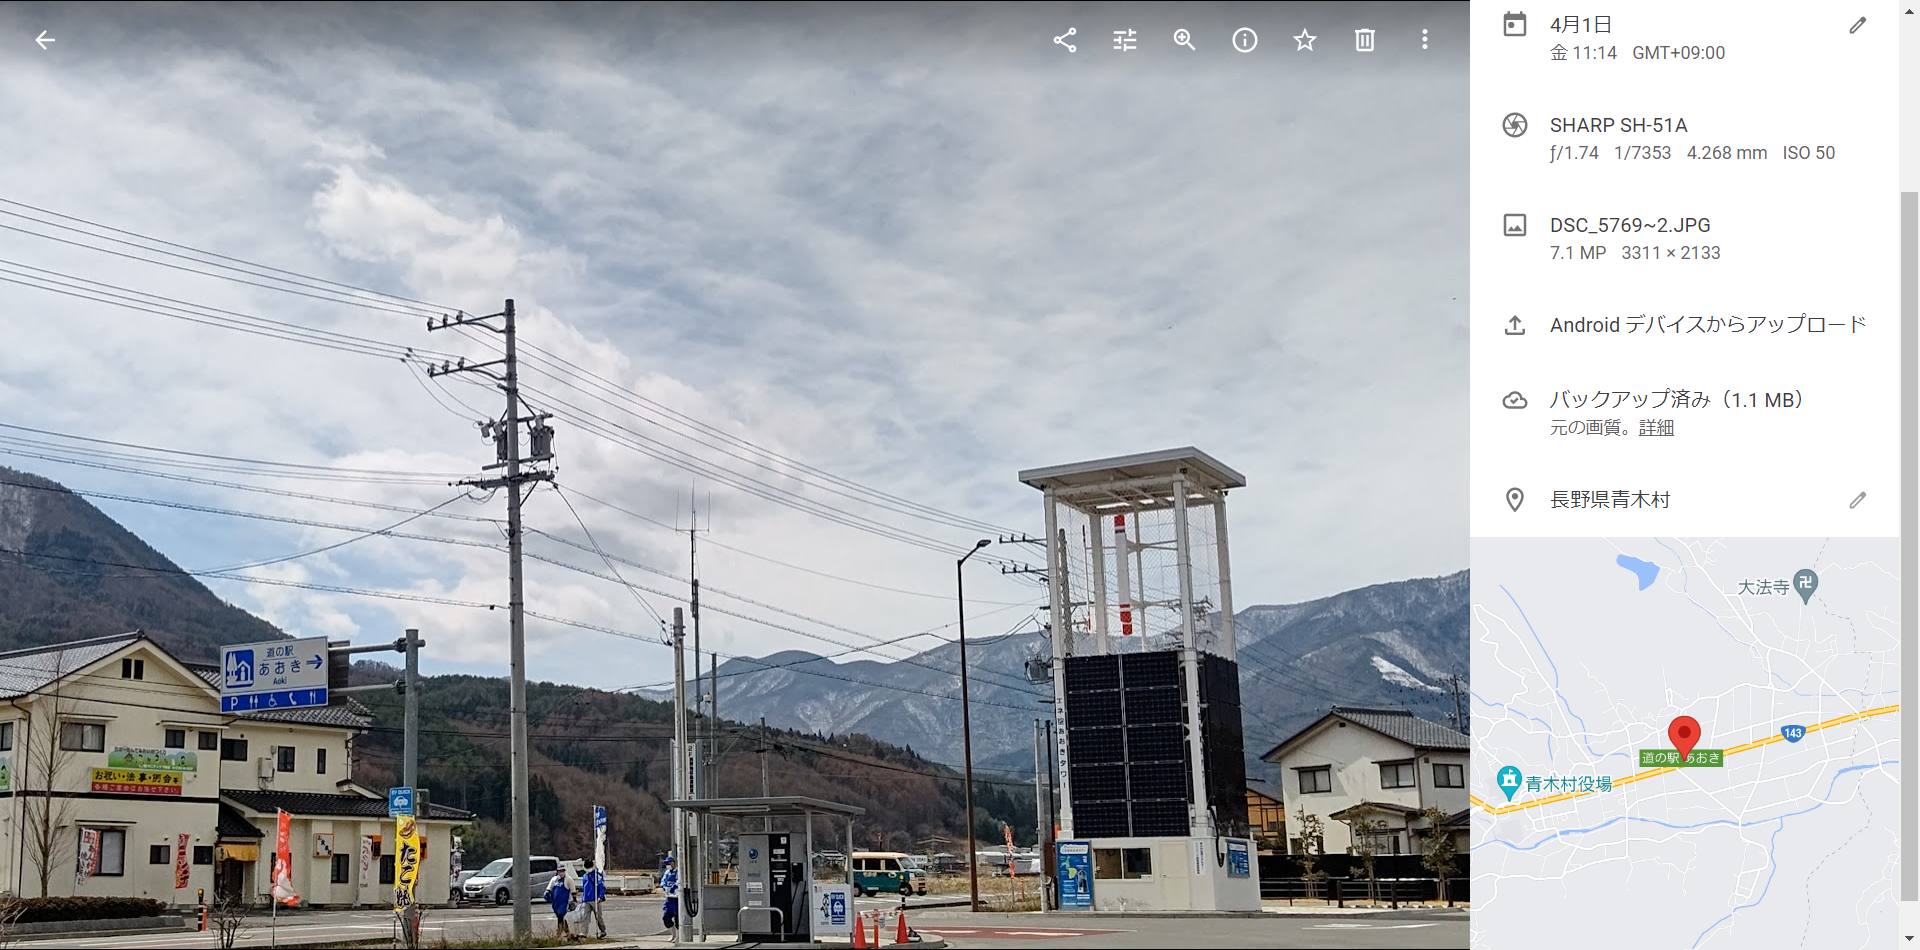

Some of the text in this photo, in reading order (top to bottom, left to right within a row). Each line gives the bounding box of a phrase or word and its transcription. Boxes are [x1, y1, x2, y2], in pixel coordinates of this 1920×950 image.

[266, 645, 294, 658] 道の駅
[259, 660, 301, 676] あおき
[273, 677, 287, 685] Aoki
